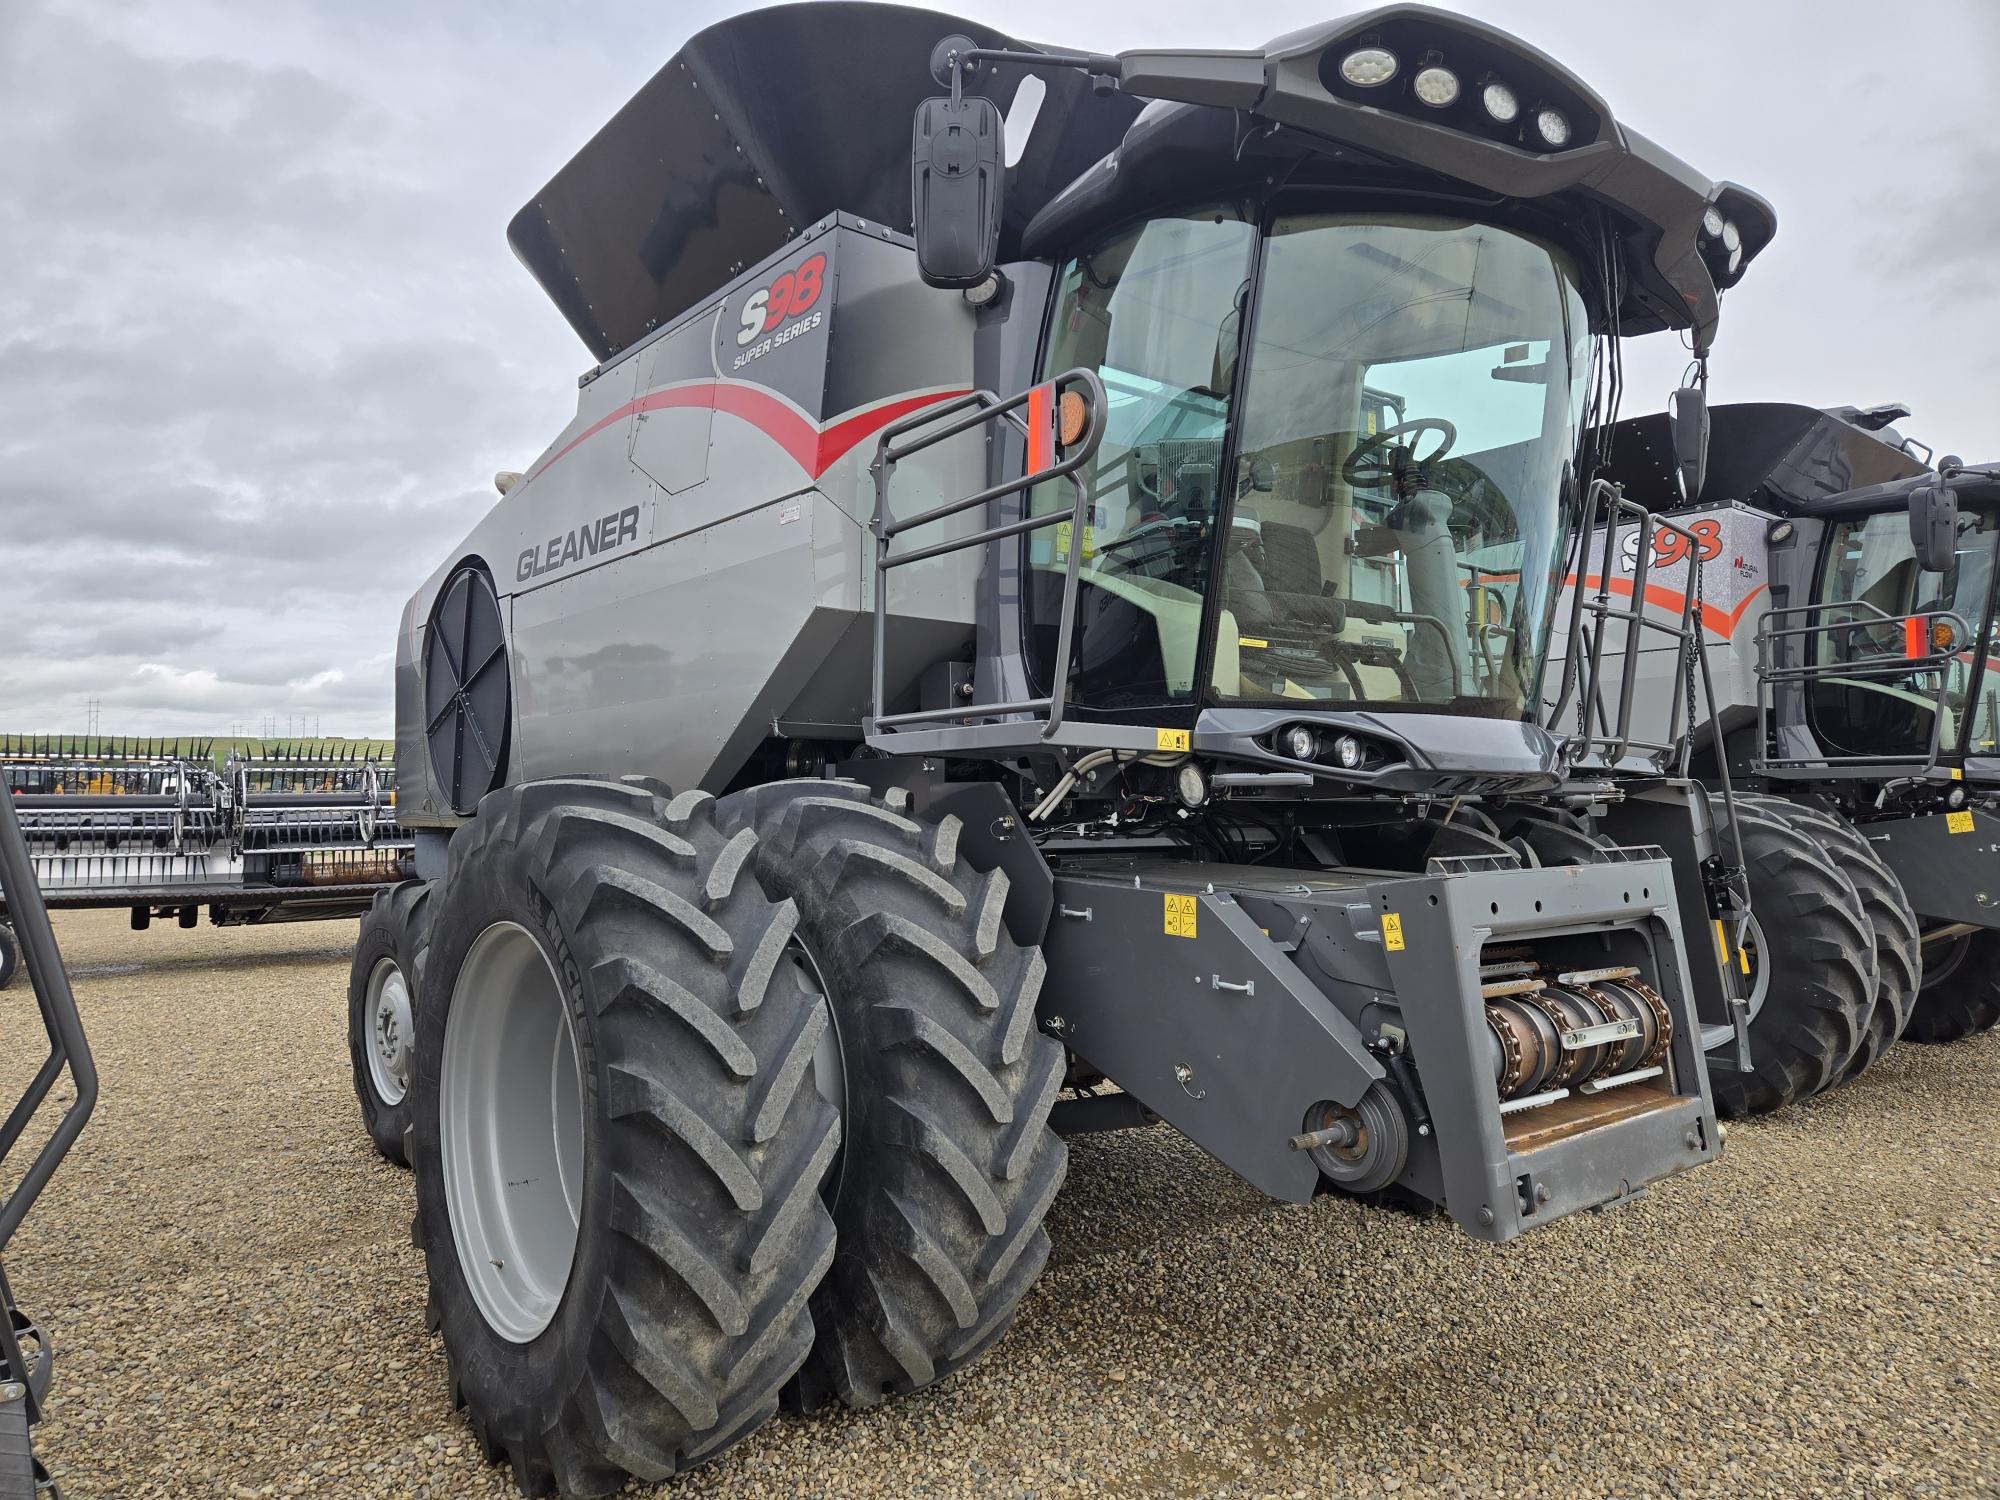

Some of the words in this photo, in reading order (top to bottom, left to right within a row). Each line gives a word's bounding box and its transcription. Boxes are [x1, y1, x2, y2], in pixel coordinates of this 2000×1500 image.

[737, 251, 828, 347] S98
[733, 338, 771, 370] SUPER
[773, 311, 822, 348] SERIES
[516, 505, 639, 582] GLEANER
[1621, 519, 1722, 572] S98
